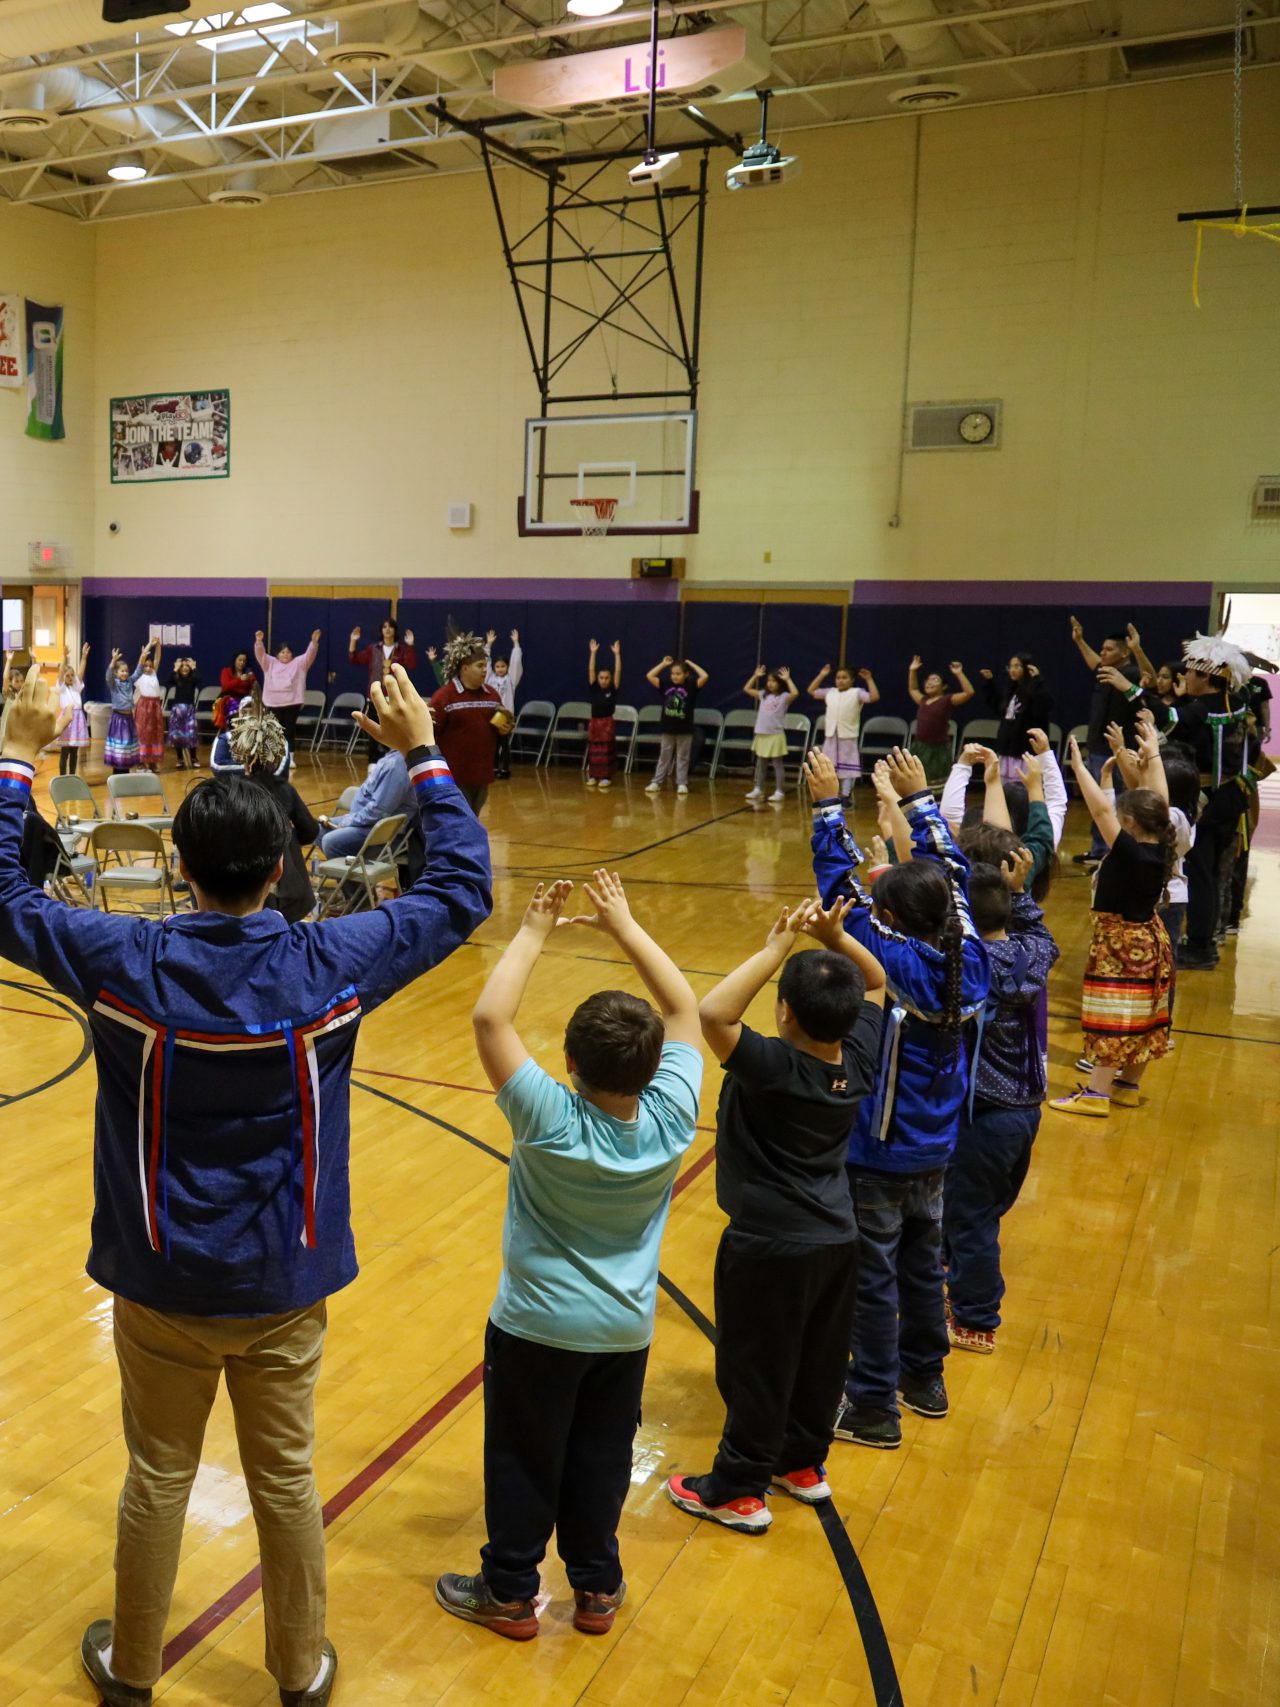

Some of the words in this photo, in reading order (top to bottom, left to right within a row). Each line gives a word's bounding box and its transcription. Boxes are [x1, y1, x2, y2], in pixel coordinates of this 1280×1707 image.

[124, 425, 150, 444] JOIN
[152, 423, 175, 443] THE
[176, 420, 214, 441] TEAM!
